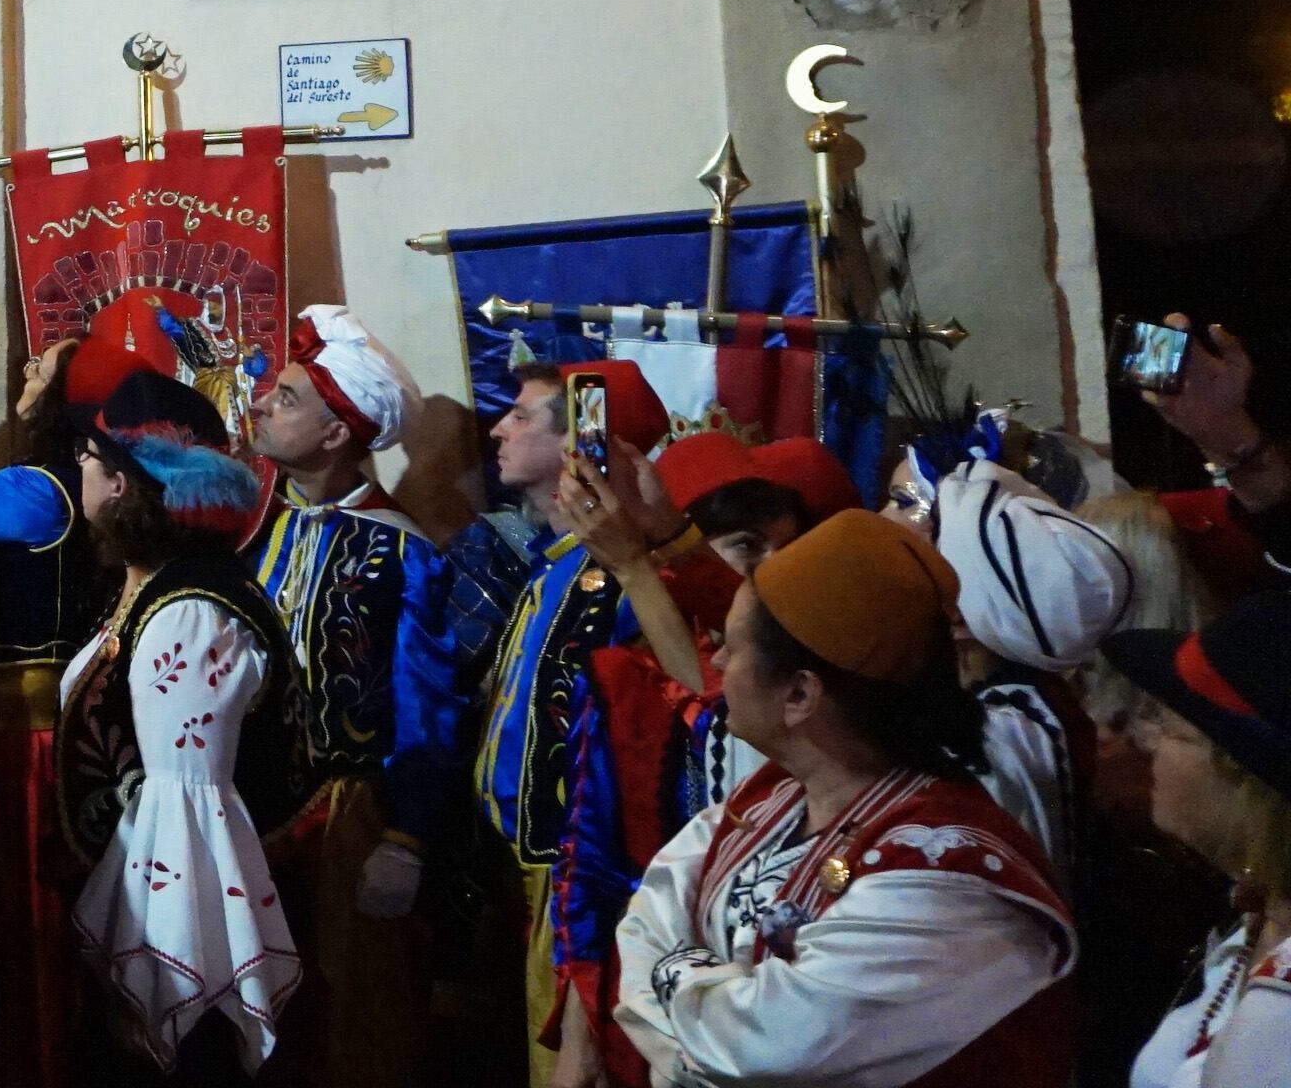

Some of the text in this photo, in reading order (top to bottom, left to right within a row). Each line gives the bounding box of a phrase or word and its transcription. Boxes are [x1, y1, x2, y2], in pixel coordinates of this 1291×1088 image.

[286, 53, 332, 65] Camino
[286, 67, 300, 78] de
[286, 77, 340, 92] Santiago
[286, 89, 352, 104] del Sureste
